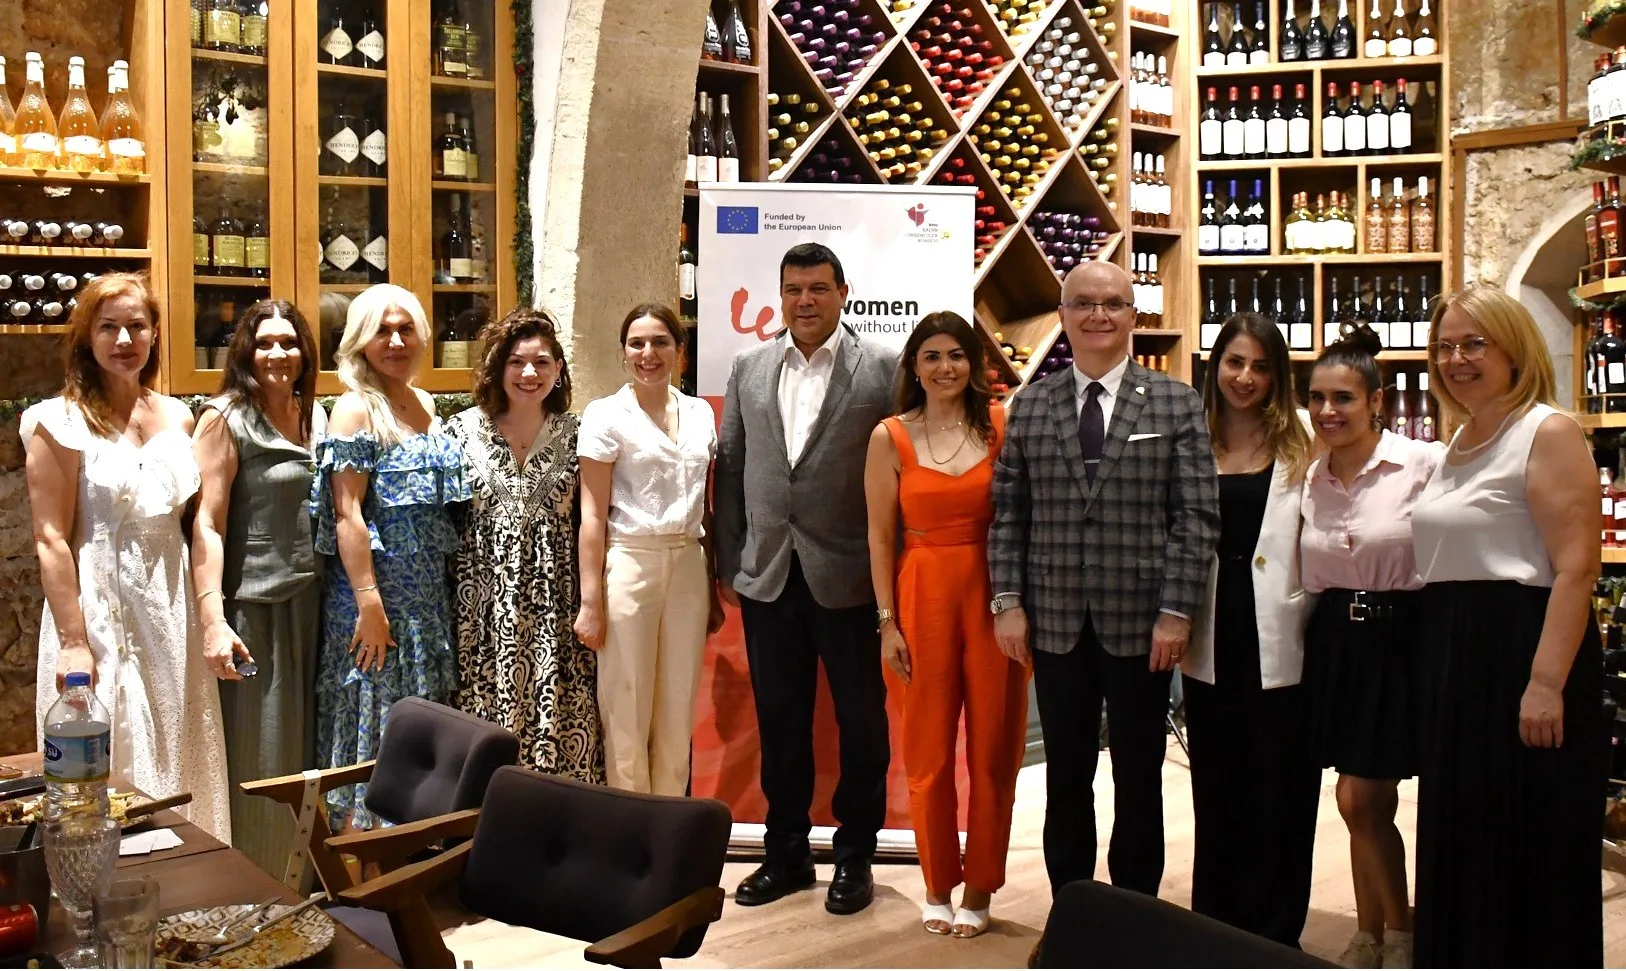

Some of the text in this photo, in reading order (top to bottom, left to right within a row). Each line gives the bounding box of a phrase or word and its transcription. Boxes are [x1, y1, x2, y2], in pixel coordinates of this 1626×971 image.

[764, 213, 806, 222] Funded by
[764, 223, 777, 231] the
[778, 223, 817, 232] European
[850, 320, 907, 333] without
